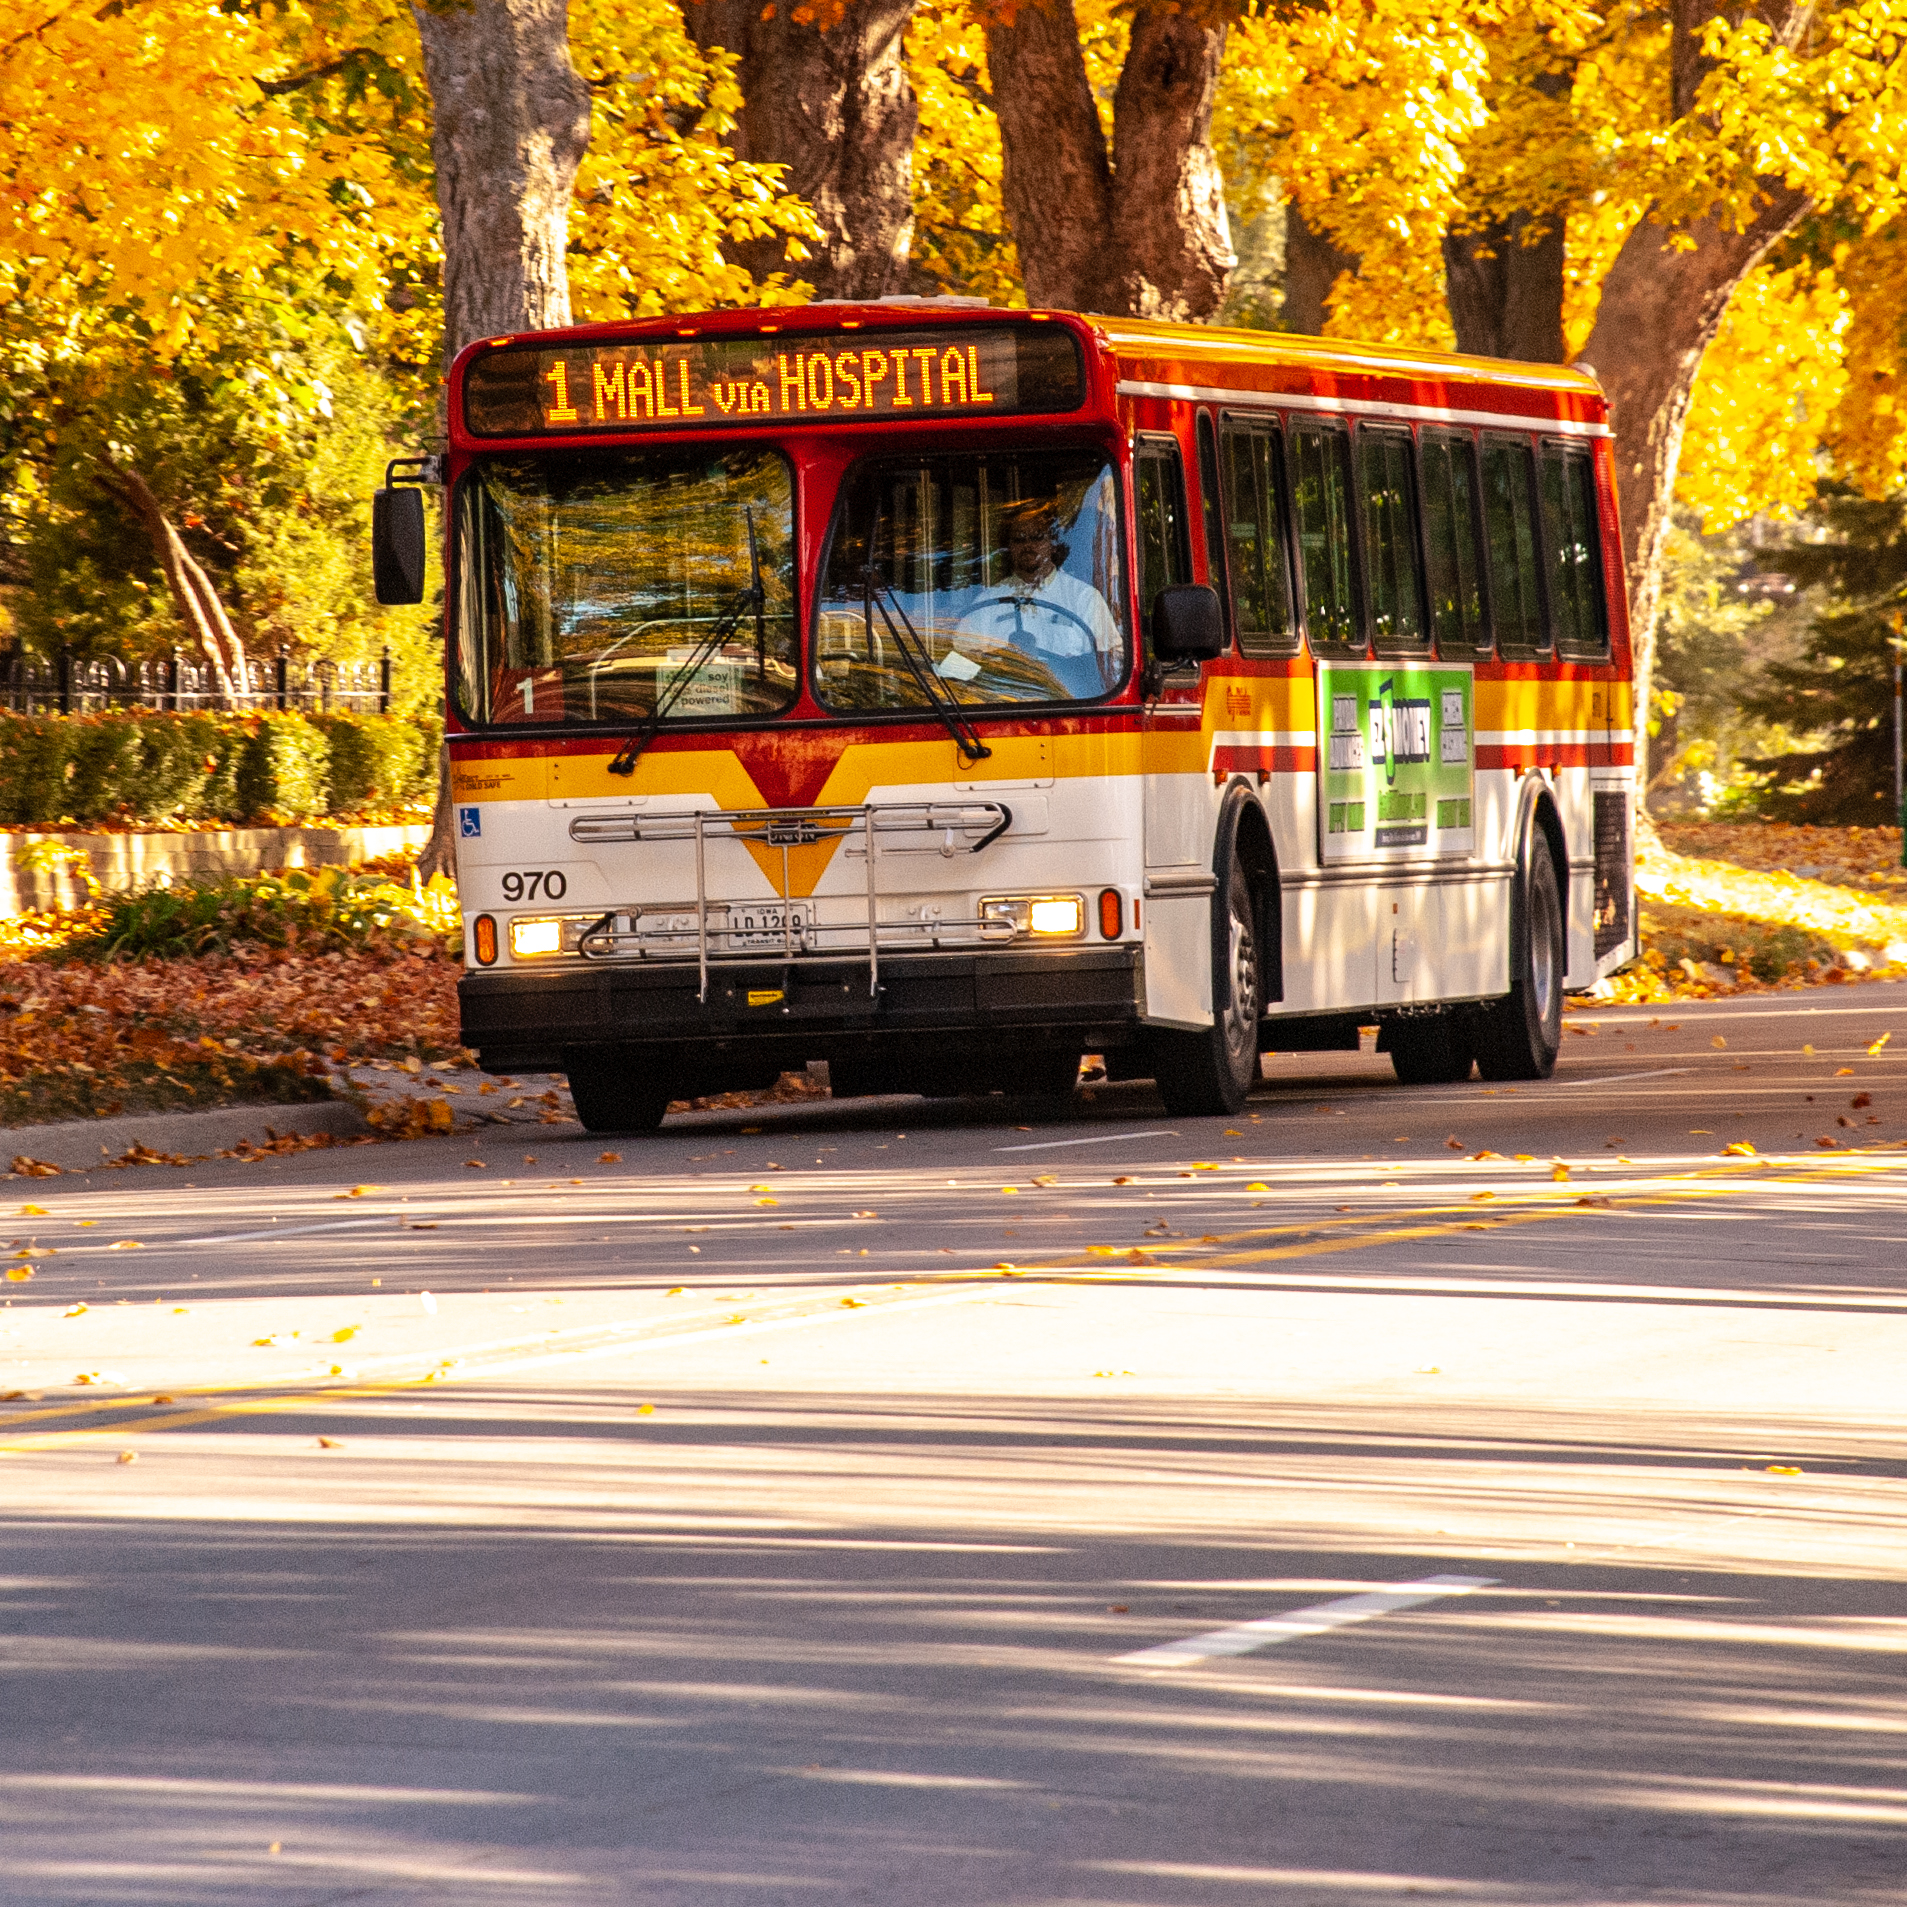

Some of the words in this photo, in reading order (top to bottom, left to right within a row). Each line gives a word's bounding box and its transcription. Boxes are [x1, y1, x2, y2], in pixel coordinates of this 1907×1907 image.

[547, 361, 577, 421] 1
[593, 359, 704, 419] MALL
[713, 381, 770, 413] VIA
[779, 345, 994, 411] HOSPITAL
[707, 673, 728, 683] soy
[516, 677, 534, 714] 1
[681, 694, 729, 708] powered
[502, 870, 567, 902] 970
